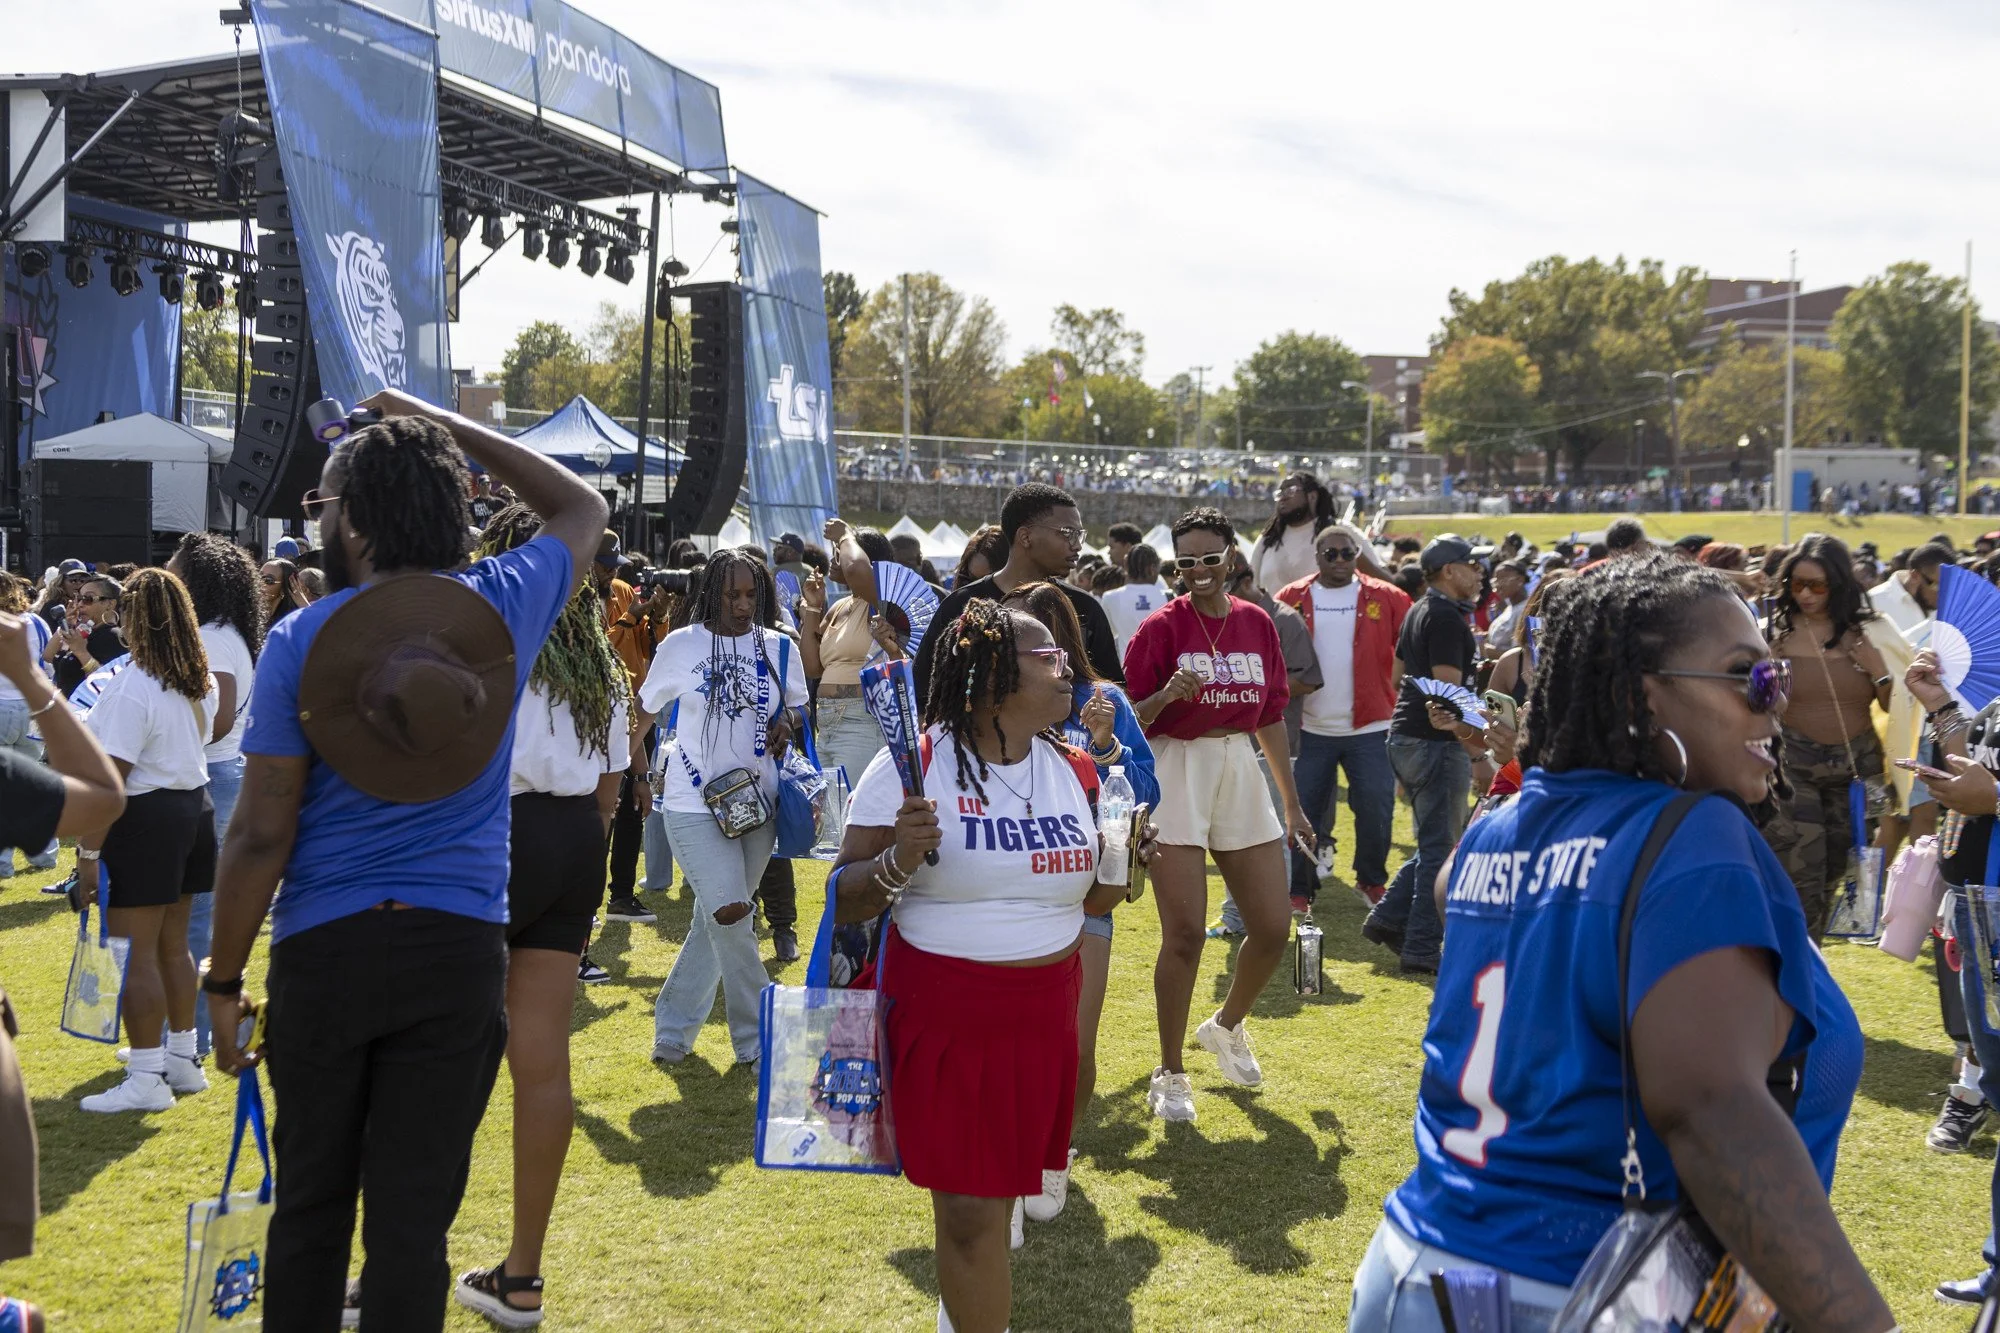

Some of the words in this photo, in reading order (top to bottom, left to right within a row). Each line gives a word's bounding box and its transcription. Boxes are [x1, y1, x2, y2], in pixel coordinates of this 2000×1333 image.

[545, 31, 632, 96] pandora
[758, 674, 769, 698] TSU
[1200, 689, 1238, 708] Alpha
[1240, 688, 1260, 703] Chi
[957, 796, 986, 816] LIL
[960, 813, 1088, 852] TIGERS
[1031, 849, 1093, 874] CHEER
[847, 1062, 863, 1071] THE
[1442, 961, 1509, 1169] 1
[836, 1093, 853, 1103] POP
[855, 1095, 872, 1104] OUT
